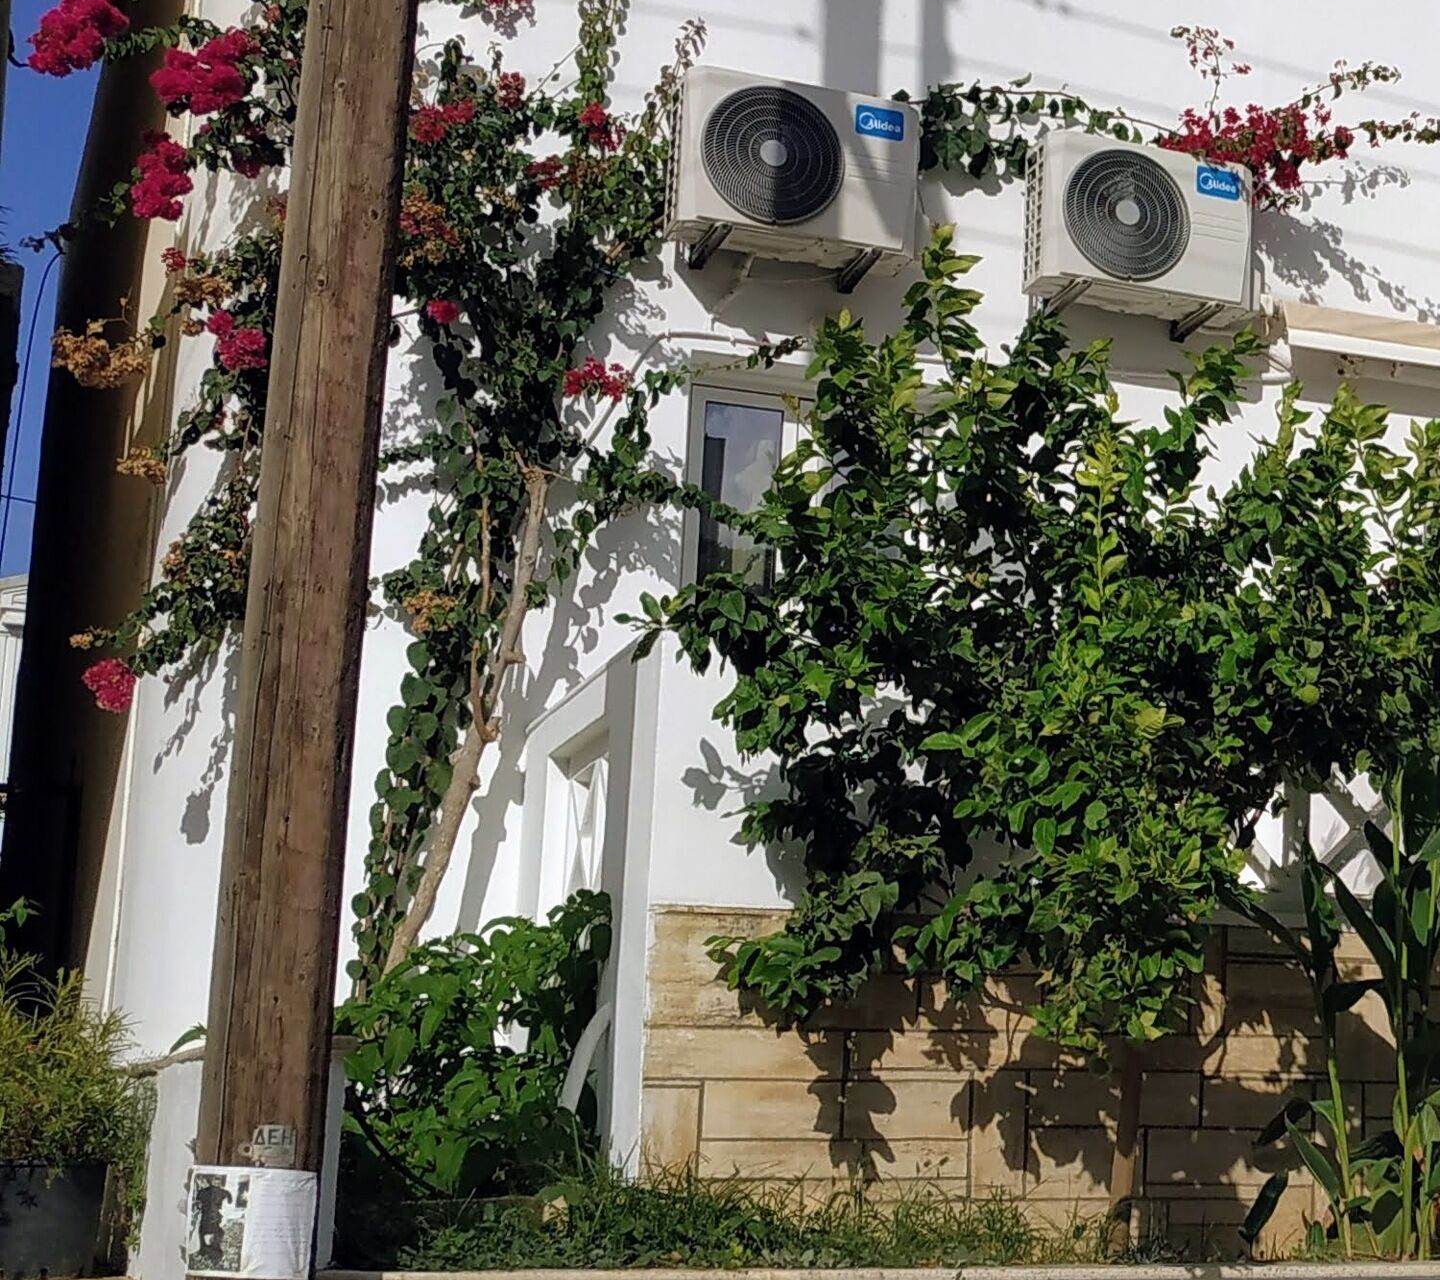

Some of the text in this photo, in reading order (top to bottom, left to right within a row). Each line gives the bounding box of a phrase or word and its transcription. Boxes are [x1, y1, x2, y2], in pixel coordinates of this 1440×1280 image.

[859, 112, 901, 133] Midea
[1200, 173, 1236, 194] Midea
[254, 1128, 294, 1145] ΔΕΗ
